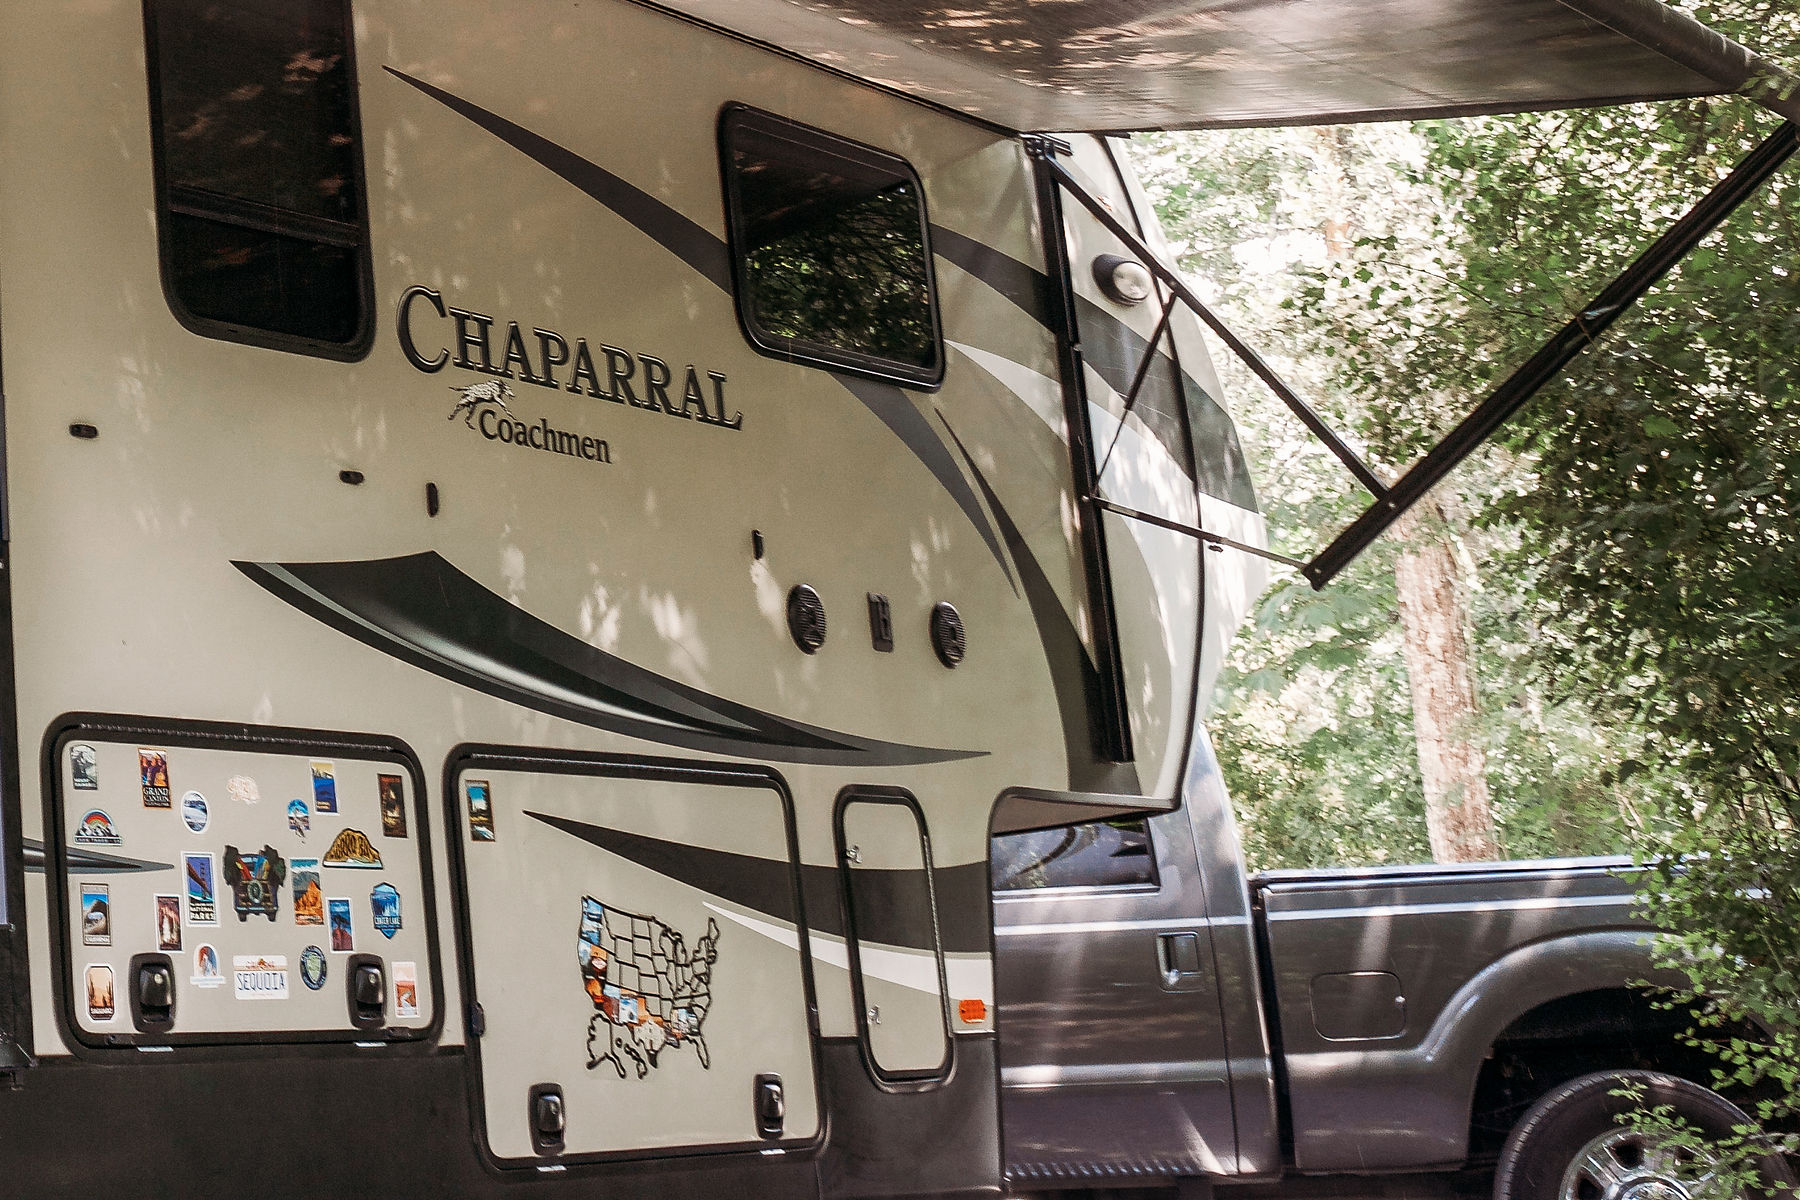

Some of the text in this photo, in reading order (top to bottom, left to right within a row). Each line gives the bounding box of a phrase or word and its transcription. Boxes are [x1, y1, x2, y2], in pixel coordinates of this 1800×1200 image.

[396, 284, 743, 430] CHAPARRAL
[478, 407, 613, 464] Coachmen
[236, 972, 286, 991] SEQUOIA
